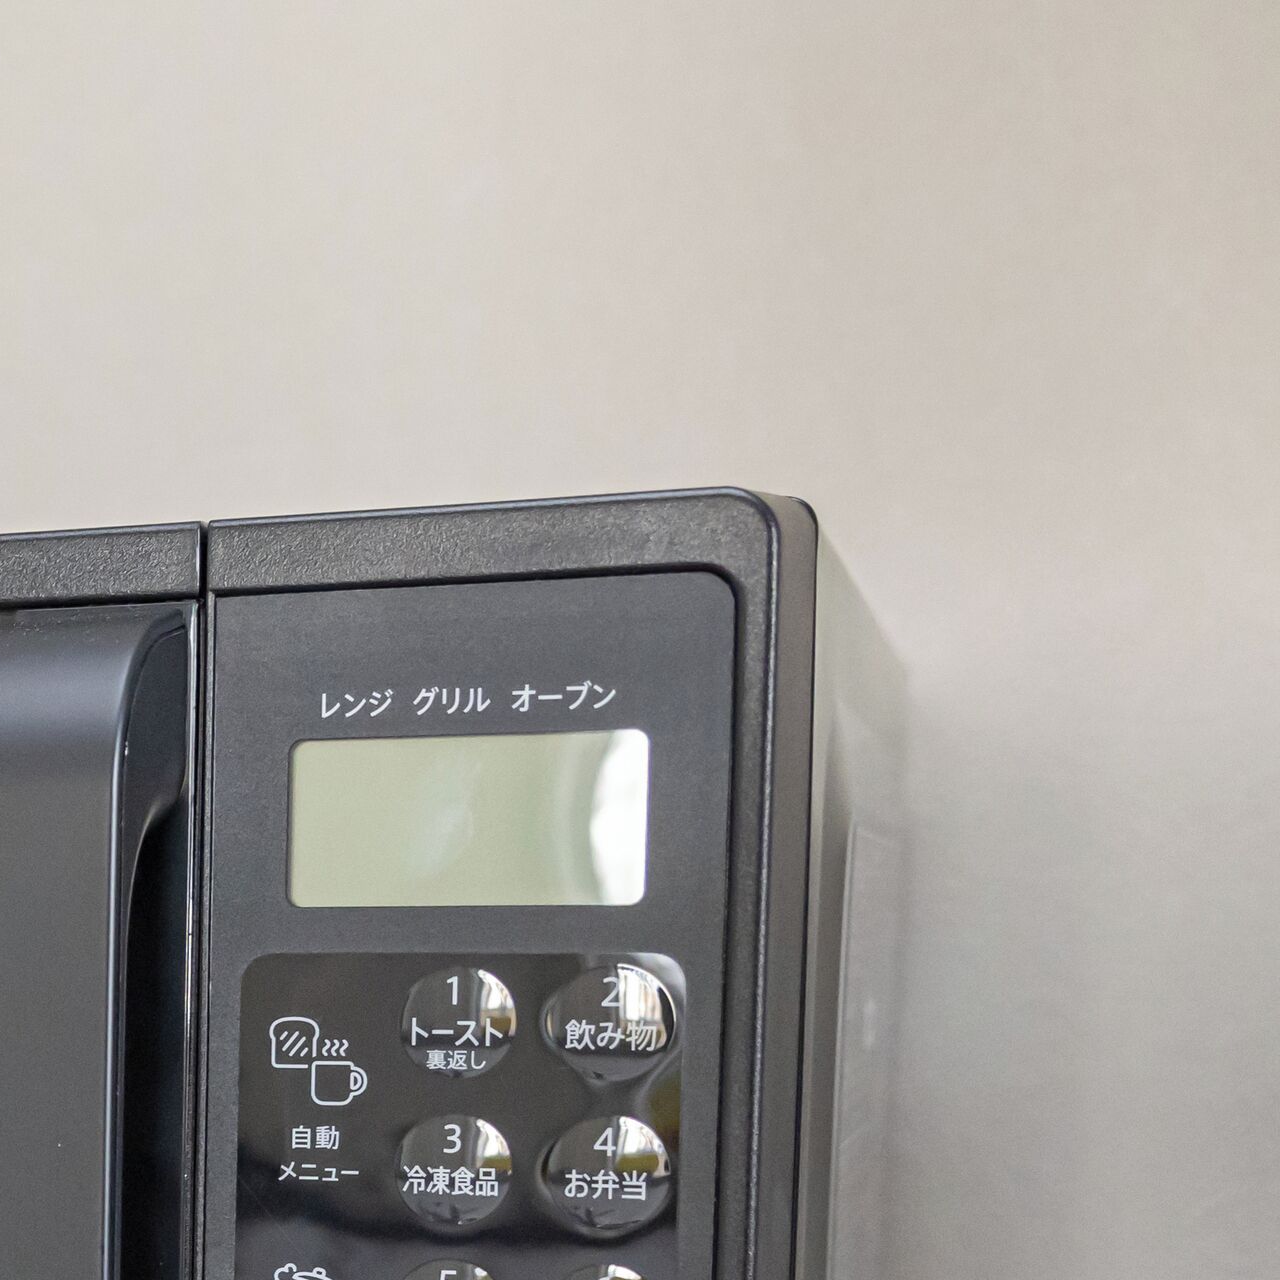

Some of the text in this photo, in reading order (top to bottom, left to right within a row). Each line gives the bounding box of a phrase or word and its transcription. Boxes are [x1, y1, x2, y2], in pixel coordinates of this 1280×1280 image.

[320, 680, 617, 719] レンジ グリル オーブン
[447, 976, 459, 1005] 1
[600, 977, 621, 1008] 2
[410, 1017, 504, 1047] トースト
[565, 1019, 657, 1051] 飲み物
[426, 1049, 486, 1070] 裏返し
[291, 1125, 339, 1151] 自動
[443, 1124, 461, 1153] 3
[594, 1127, 616, 1157] 4
[278, 1161, 359, 1183] メニュー
[402, 1167, 499, 1198] 冷凍食品
[564, 1169, 648, 1201] お弁当
